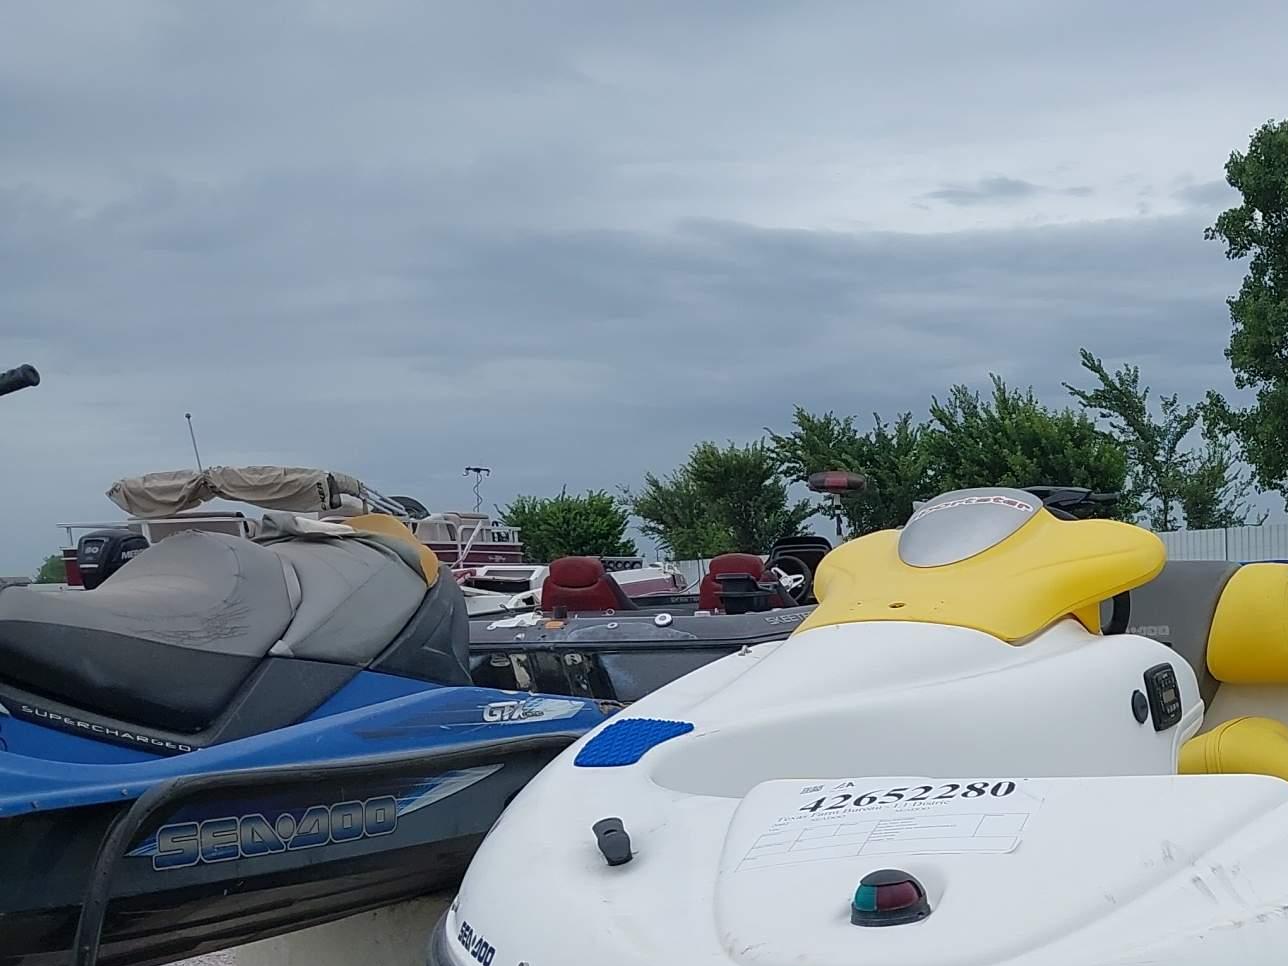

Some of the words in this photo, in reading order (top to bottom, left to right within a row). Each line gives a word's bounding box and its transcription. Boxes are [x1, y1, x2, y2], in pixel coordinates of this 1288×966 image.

[483, 700, 526, 722] GTX
[21, 705, 192, 752] SUPERCHARGED
[800, 781, 1016, 813] 42652280
